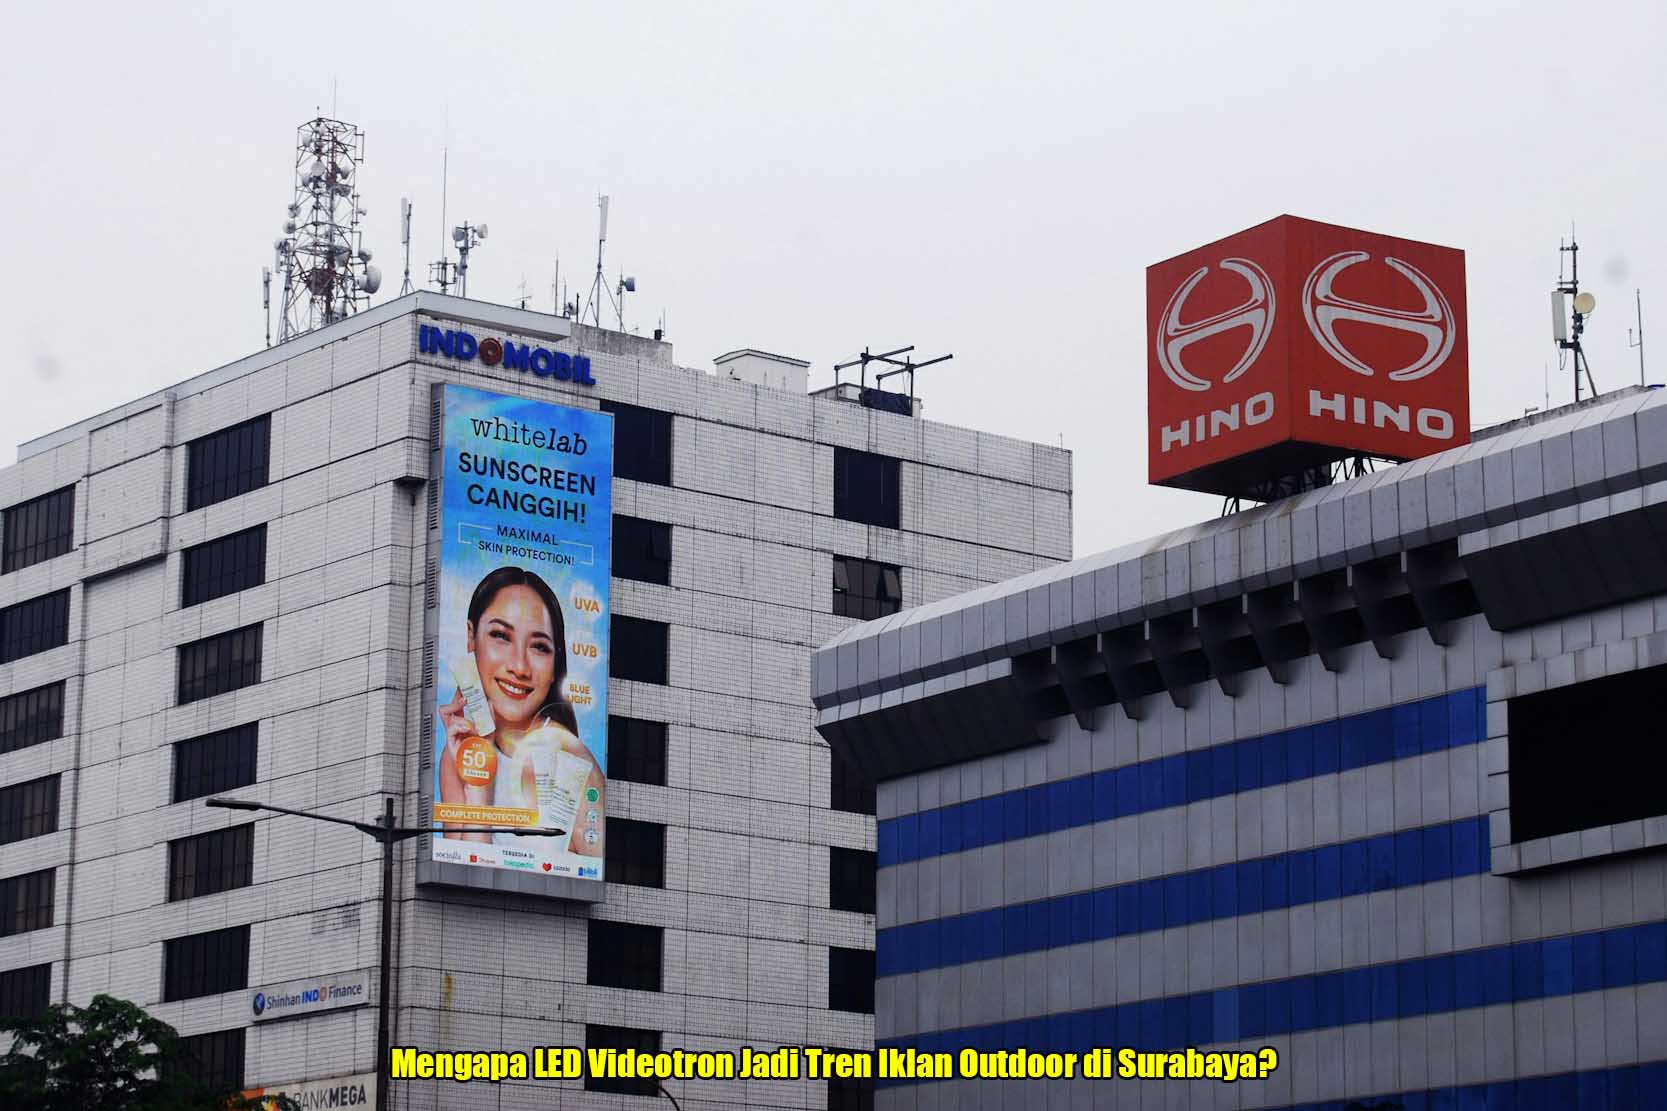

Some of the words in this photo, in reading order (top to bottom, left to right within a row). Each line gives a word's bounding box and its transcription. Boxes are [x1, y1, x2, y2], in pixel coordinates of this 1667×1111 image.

[419, 324, 596, 385] INDOMOBIL
[1161, 391, 1274, 453] HINO
[1309, 389, 1454, 440] HINO
[470, 416, 588, 456] whitelab
[458, 452, 596, 496] SUNSCREEN
[467, 484, 587, 524] CANGGIH!
[496, 525, 559, 546] MAXIMAL
[478, 540, 503, 554] SKIN
[505, 545, 575, 566] PROTECTION!
[574, 596, 600, 613] UVA
[572, 643, 598, 658] UVB
[569, 683, 591, 695] BLUE
[462, 749, 486, 769] 50
[440, 808, 481, 820] COMPLETE
[482, 812, 530, 825] PROTECTION
[266, 992, 301, 1009] Shinhan
[328, 983, 363, 1000] Finance
